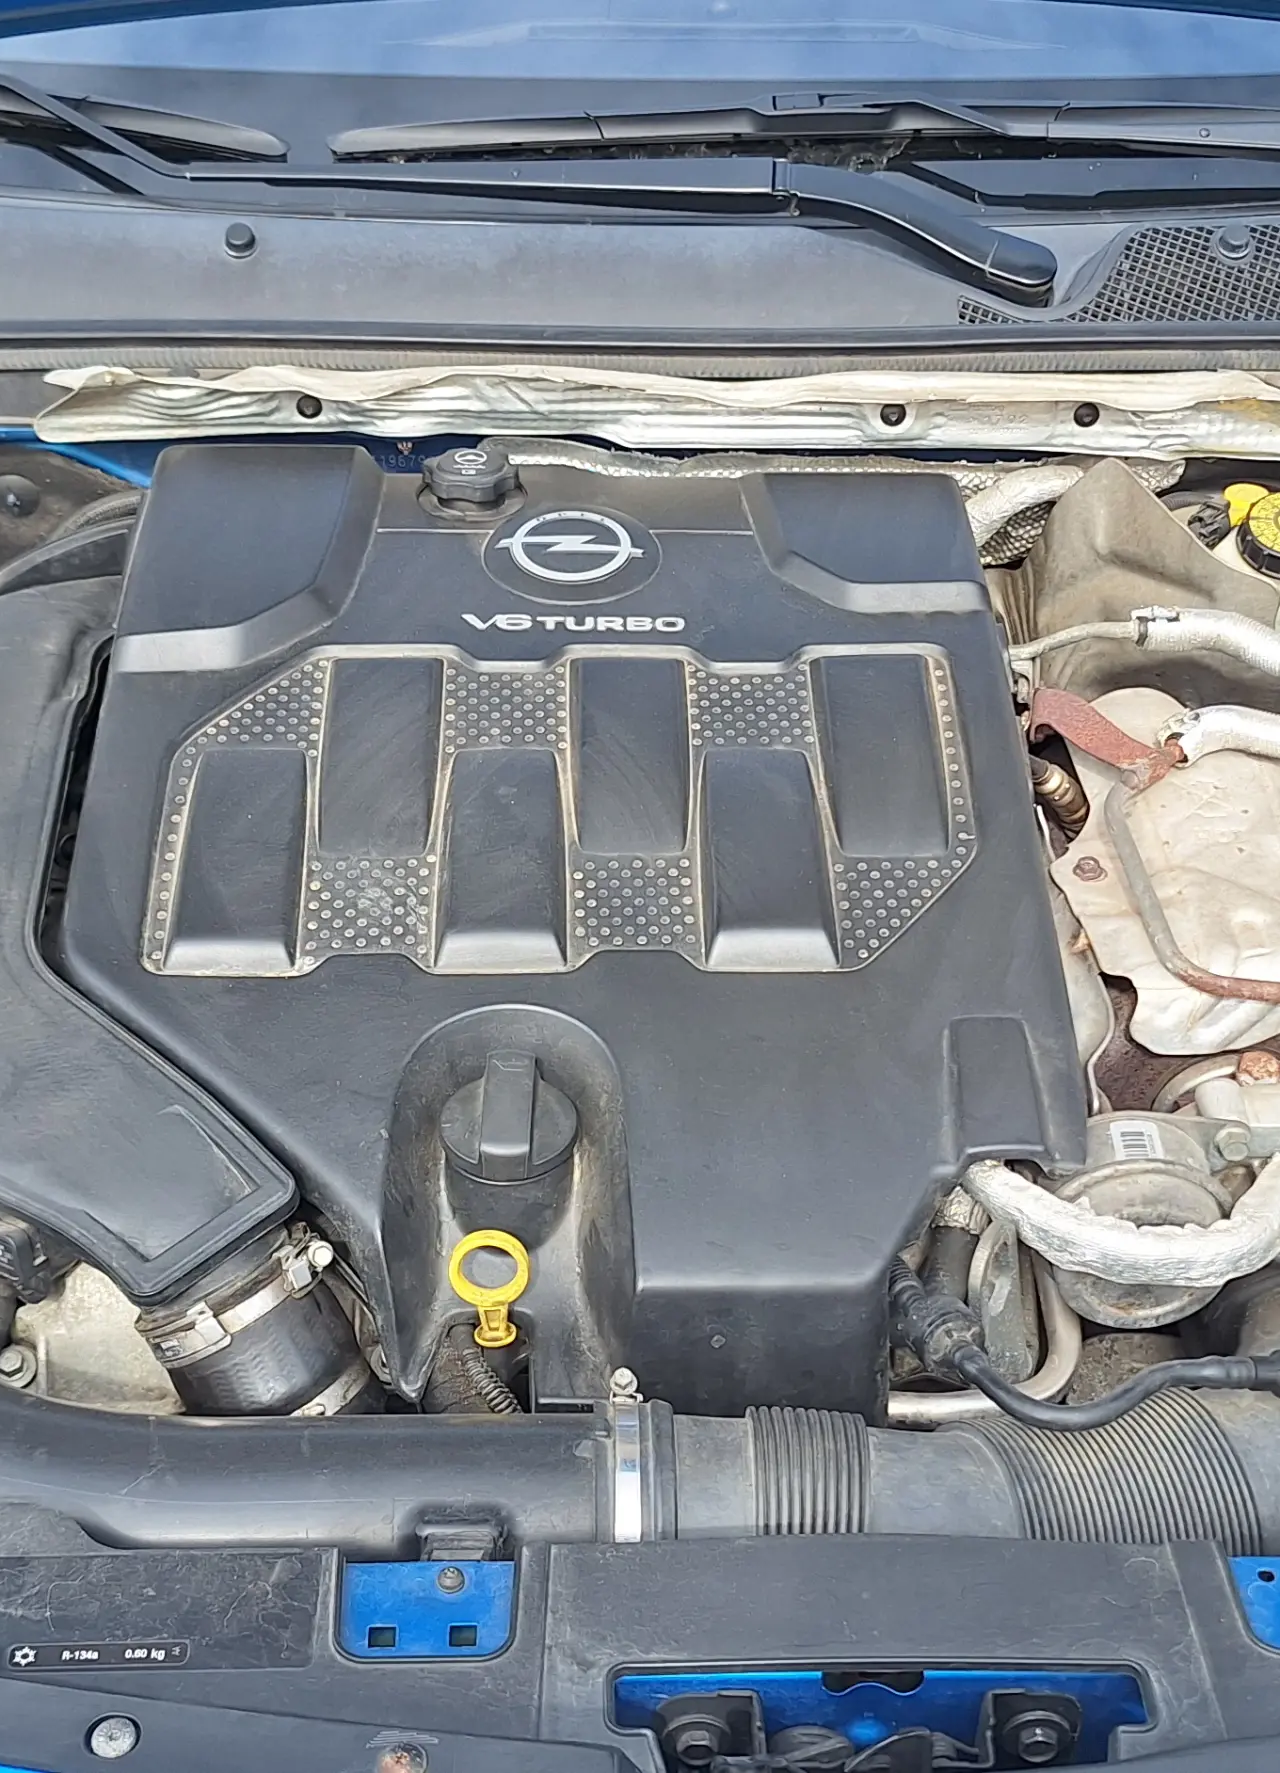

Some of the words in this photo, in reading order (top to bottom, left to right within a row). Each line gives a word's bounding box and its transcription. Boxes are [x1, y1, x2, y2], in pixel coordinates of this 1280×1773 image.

[461, 613, 532, 631] V6
[536, 615, 685, 632] TURBO
[61, 1649, 99, 1661] R-134a
[150, 1647, 166, 1661] kg
